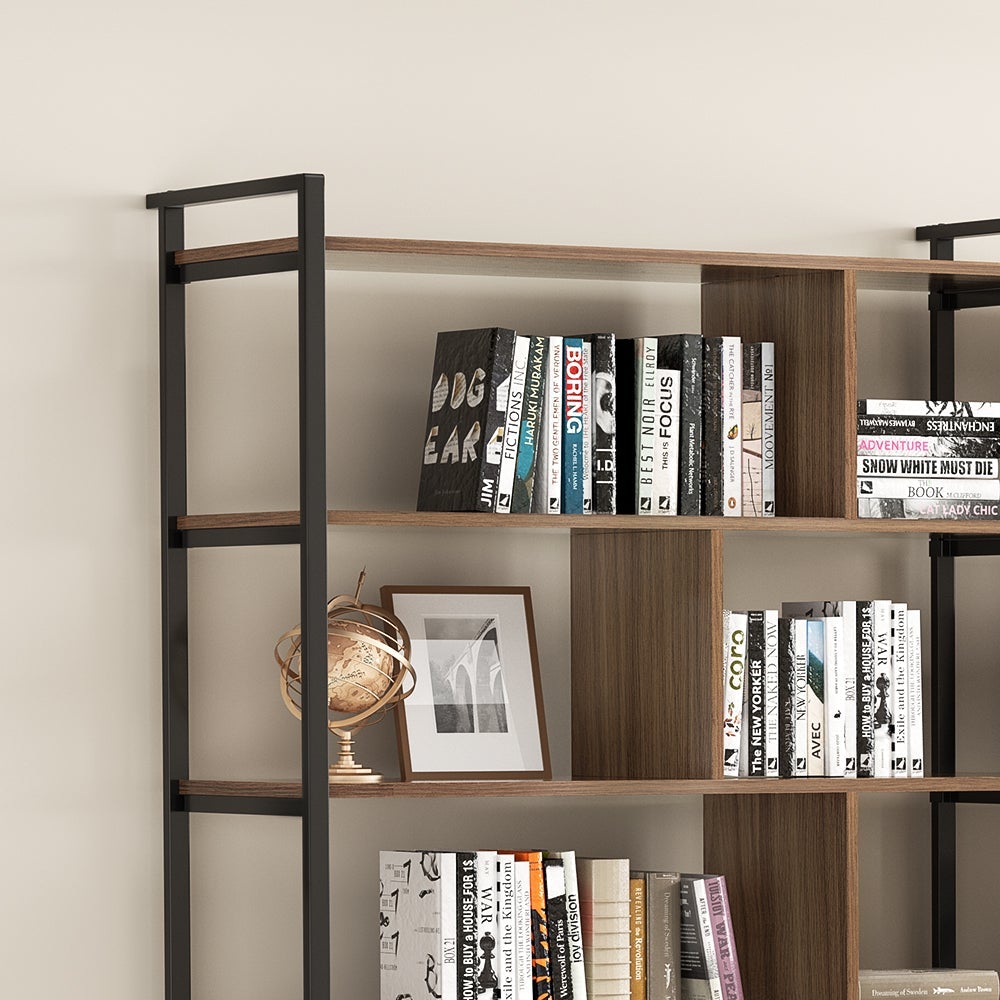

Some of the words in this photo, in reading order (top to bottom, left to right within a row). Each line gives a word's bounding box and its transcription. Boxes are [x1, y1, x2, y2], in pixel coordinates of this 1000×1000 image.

[645, 346, 655, 387] ELLROY
[554, 382, 560, 394] OF
[566, 345, 583, 434] BORING
[642, 398, 655, 435] NOIR
[659, 376, 673, 439] FOCUS
[504, 391, 522, 460] FICTIONS
[524, 403, 538, 446] HARUKI
[764, 386, 773, 470] MOOVEMENT
[926, 420, 995, 432] ENCHANTRESS
[424, 421, 481, 464] EAR
[858, 440, 929, 451] ADVENTURE
[552, 450, 560, 468] TWO
[641, 445, 653, 485] BEST
[862, 458, 897, 474] SNOW
[900, 459, 937, 474] WHITE
[940, 460, 973, 475] MUST
[975, 461, 993, 476] DIE
[552, 470, 560, 485] THE
[481, 479, 495, 507] JIM
[907, 486, 944, 498] BOOK
[942, 505, 970, 516] LADY
[973, 505, 998, 516] CHIC
[767, 621, 777, 658] NOW
[862, 620, 872, 640] FOR
[896, 610, 906, 662] Kingdom
[729, 629, 745, 690] coro
[862, 641, 872, 674] HOUSE
[877, 633, 888, 666] WAR
[750, 660, 762, 715] YORKER
[767, 663, 778, 715] NAKED
[896, 666, 905, 686] the
[862, 683, 872, 702] BUY
[896, 687, 905, 710] and
[796, 696, 806, 721] NEW
[862, 704, 872, 715] to
[751, 716, 762, 746] NEW
[768, 715, 777, 743] THE
[811, 722, 822, 759] AVEC
[862, 718, 872, 738] HOW
[896, 713, 905, 744] Exile
[751, 750, 762, 773] The
[463, 859, 473, 872] 1$
[463, 875, 474, 898] FOR
[502, 862, 514, 919] Kingdom
[708, 880, 722, 916] TOLSTOY
[463, 899, 473, 932] HOUSE
[481, 886, 492, 924] WAR
[567, 894, 580, 942] division
[444, 938, 455, 947] 21
[466, 933, 473, 941] a
[502, 923, 512, 942] the
[555, 918, 564, 941] Paris
[715, 919, 731, 960] WAR
[444, 949, 455, 964] BOX
[463, 942, 473, 963] BUY
[502, 950, 512, 973] and
[557, 942, 565, 953] of
[635, 937, 643, 981] Revolution
[463, 965, 473, 977] to
[558, 954, 569, 997] Werewolf
